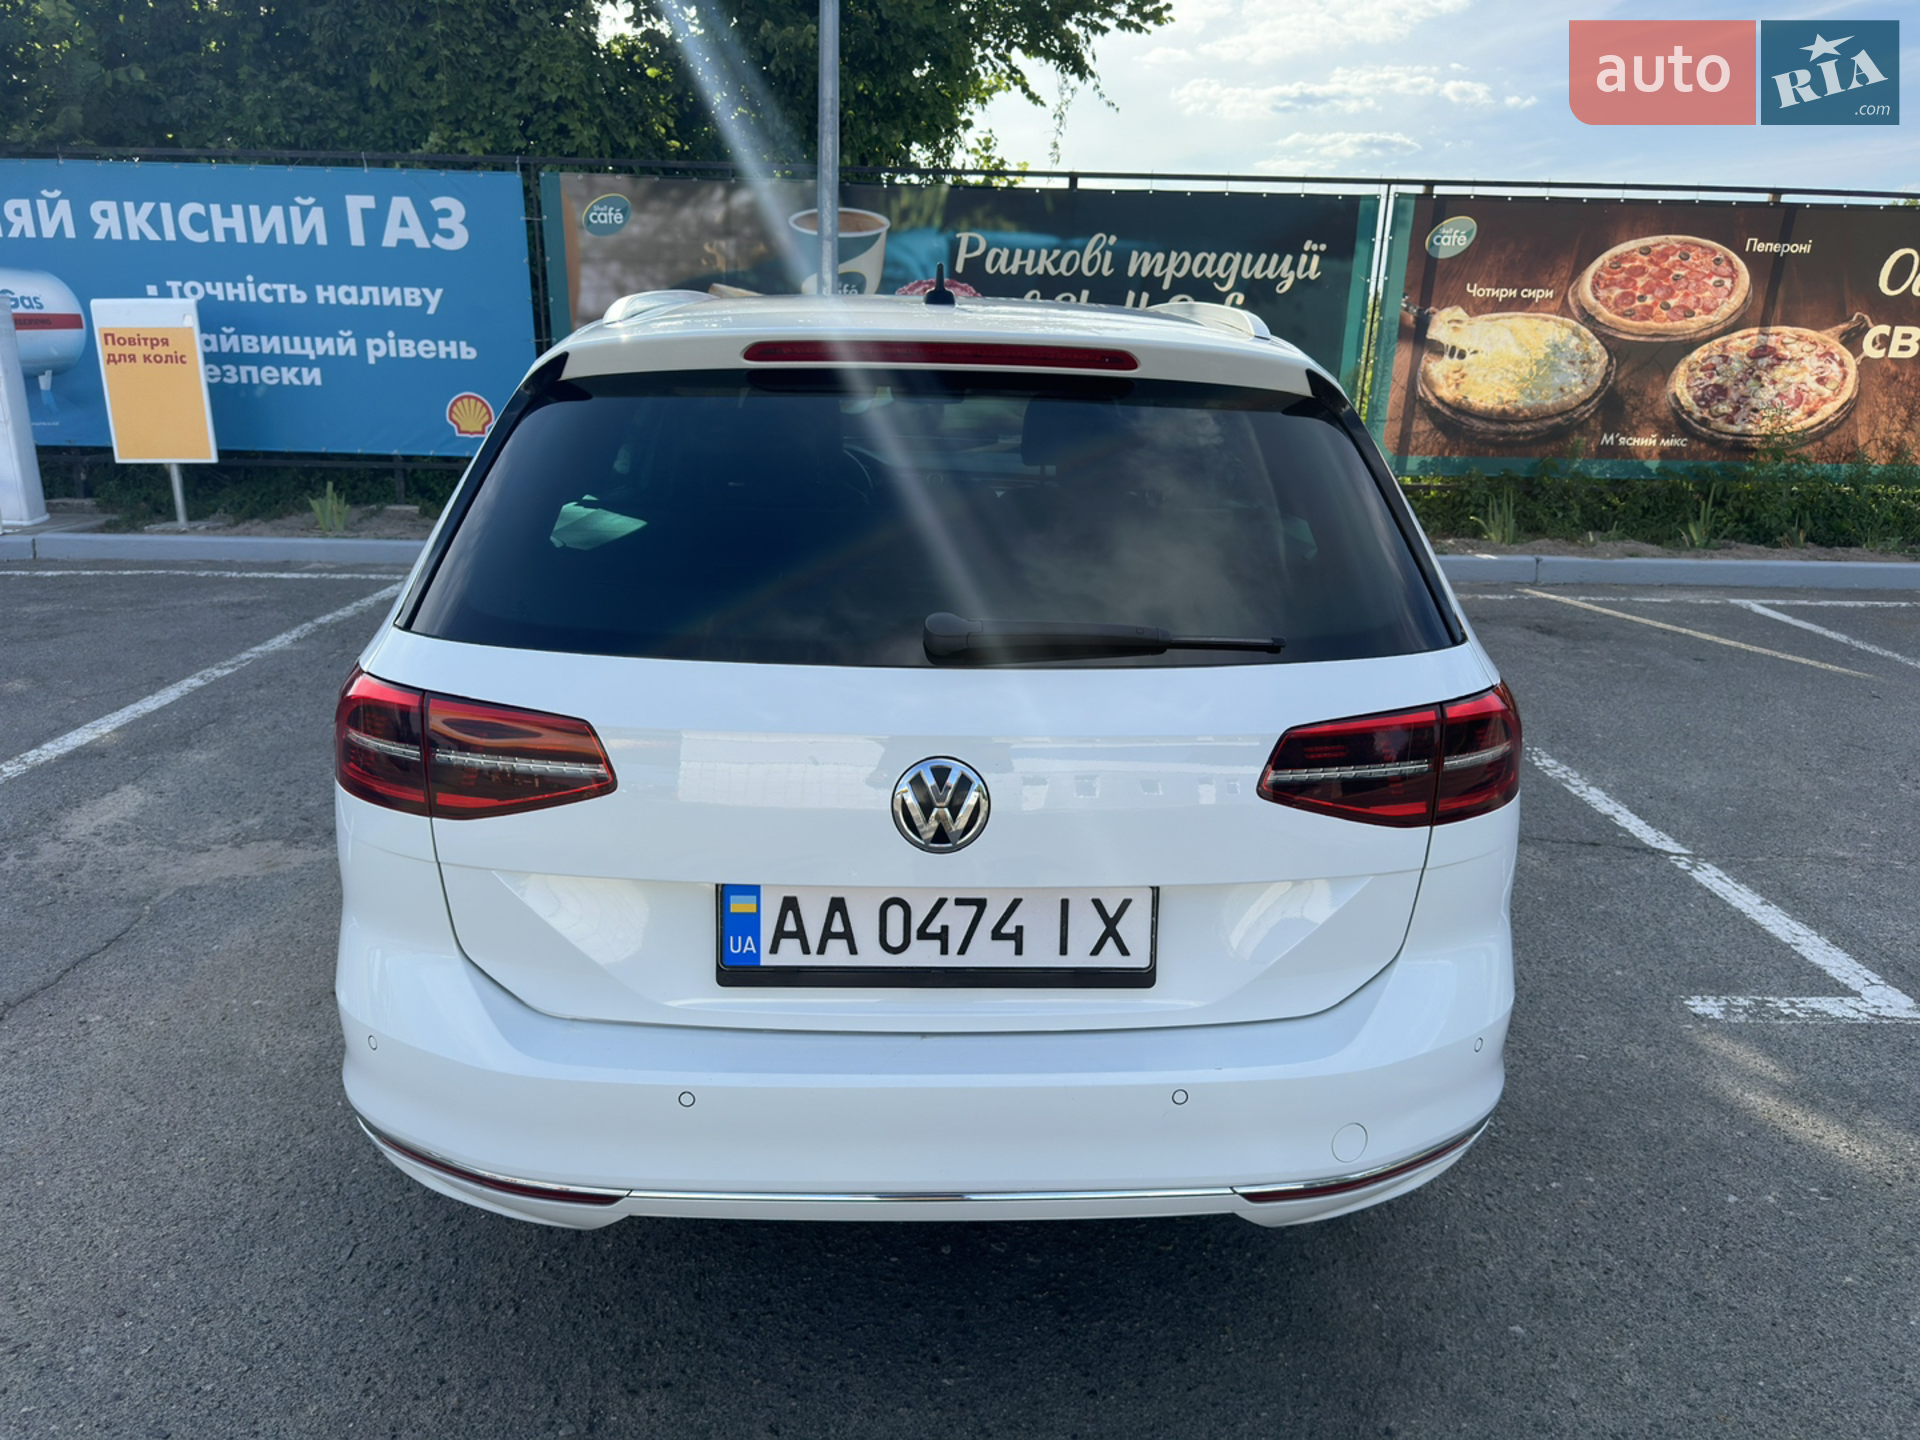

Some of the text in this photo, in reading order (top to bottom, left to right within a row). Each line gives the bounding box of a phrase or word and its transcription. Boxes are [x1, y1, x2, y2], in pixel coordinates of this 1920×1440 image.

[0, 189, 469, 251] ЯЙ ЯКІСНИЙ ГАЗ
[589, 207, 624, 224] café
[1432, 230, 1468, 246] café
[1745, 237, 1813, 257] Пепероні
[955, 232, 1327, 293] Ранкові традиції
[165, 274, 444, 315] точність наливу
[1466, 283, 1554, 303] Чотири сири
[103, 333, 169, 350] Повітря
[200, 326, 478, 365] айвищий рівень
[106, 351, 187, 365] для коліс
[205, 363, 322, 386] езпеки
[1659, 434, 1688, 447] мікс
[769, 896, 1133, 956] AA 0474 IX
[729, 936, 757, 954] UA
